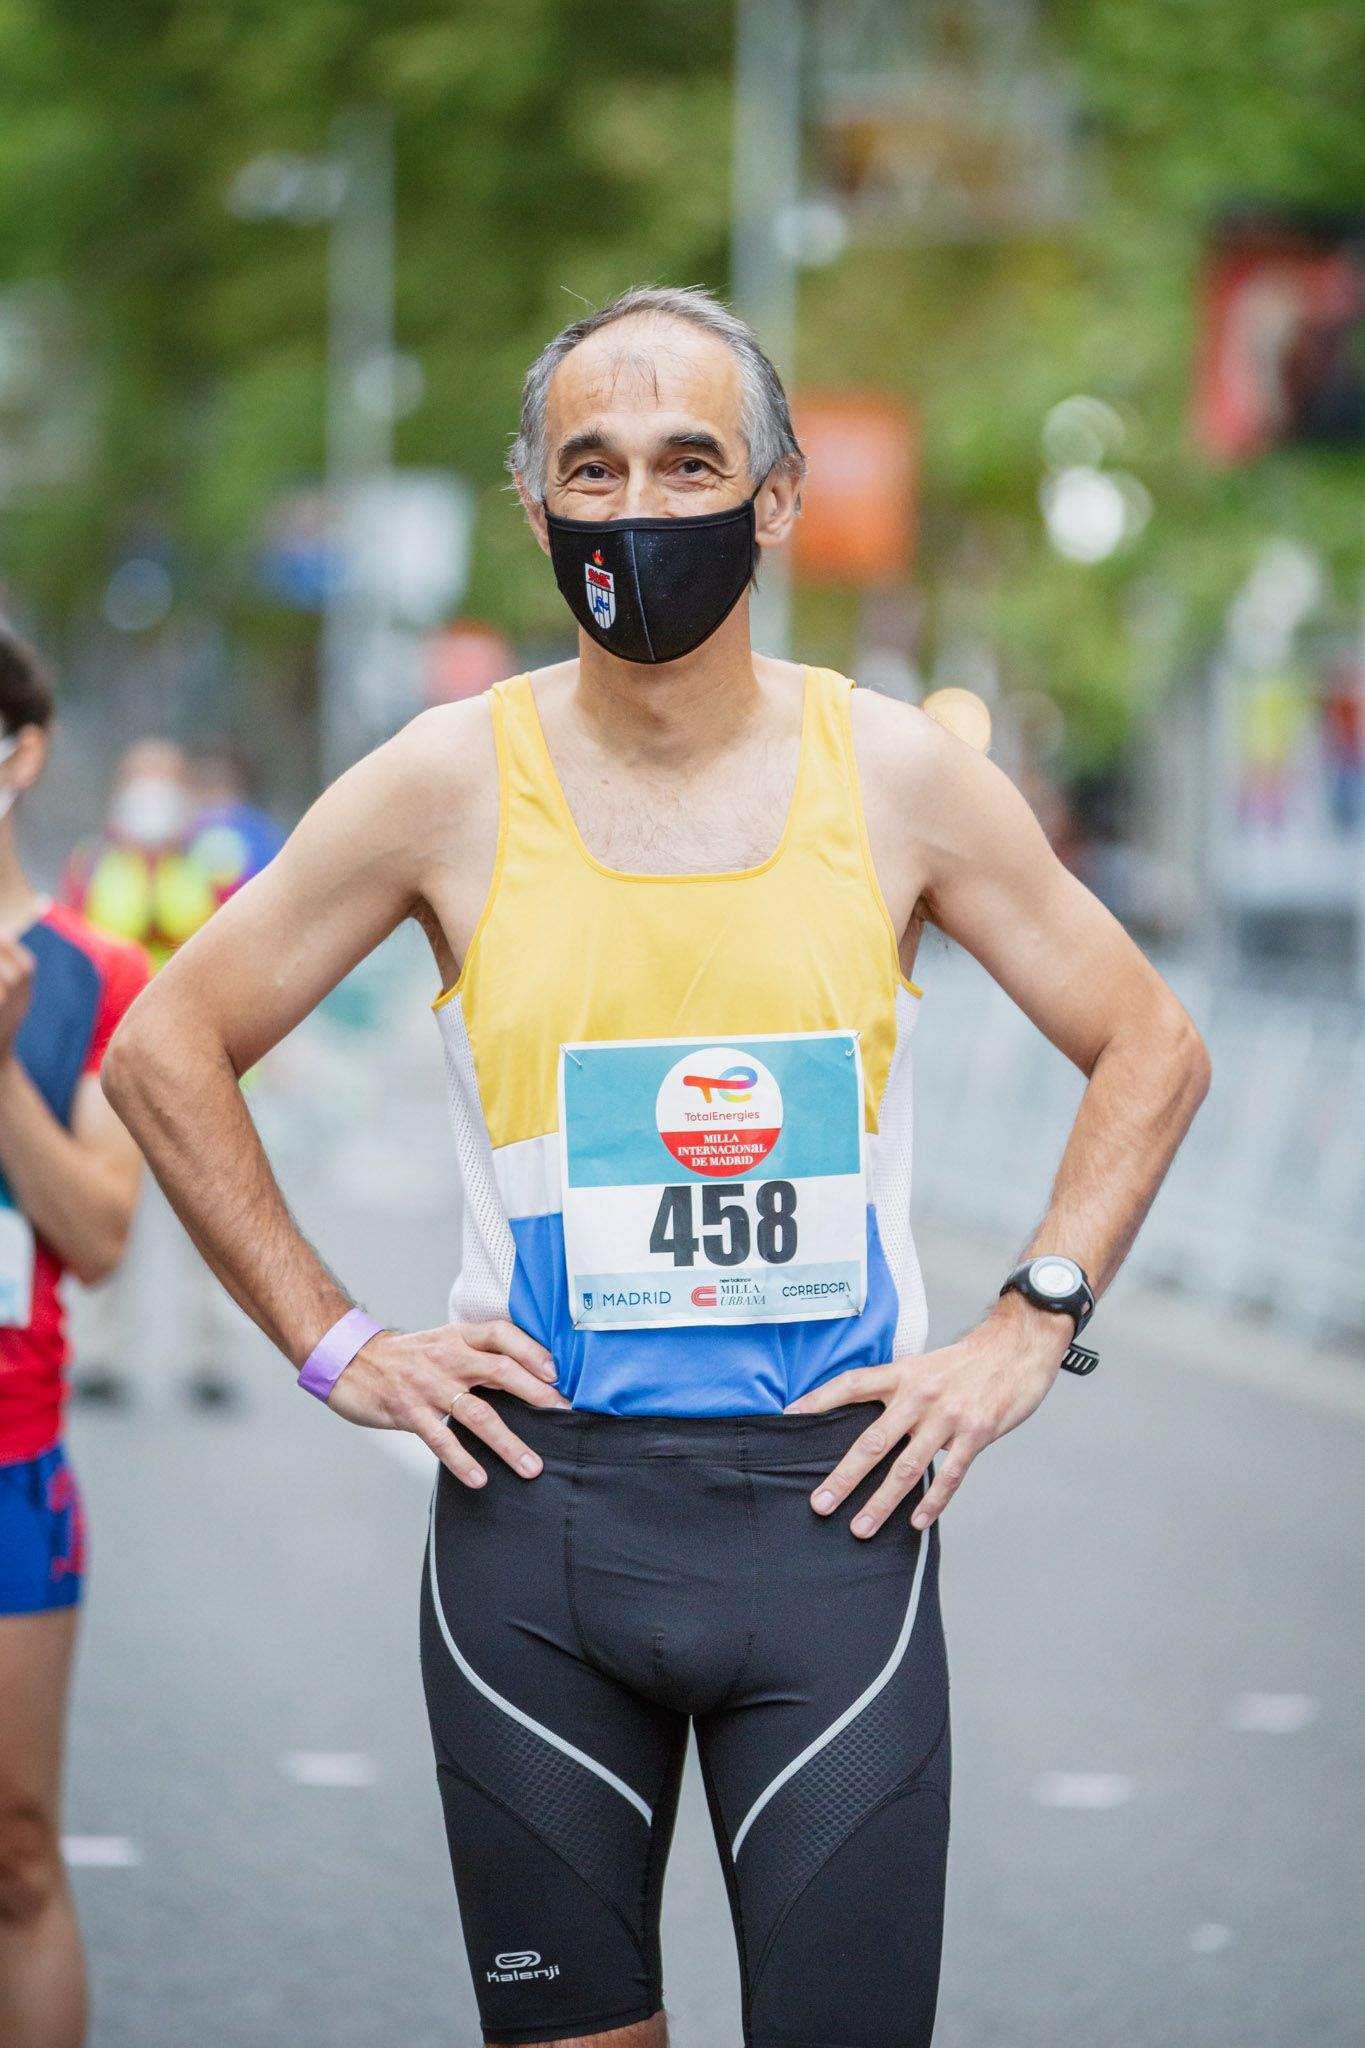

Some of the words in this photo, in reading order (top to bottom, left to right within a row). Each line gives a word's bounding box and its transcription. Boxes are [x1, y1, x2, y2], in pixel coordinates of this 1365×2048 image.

[685, 1110, 760, 1122] TotalEnergies
[704, 1134, 739, 1144] MILLA
[692, 1158, 708, 1167] DE
[709, 1155, 753, 1166] MADRID
[650, 1180, 797, 1267] 458
[721, 1284, 760, 1294] MILLA
[603, 1291, 671, 1306] MADRID
[720, 1296, 766, 1306] URBANA
[487, 1965, 560, 1983] Kalenji
